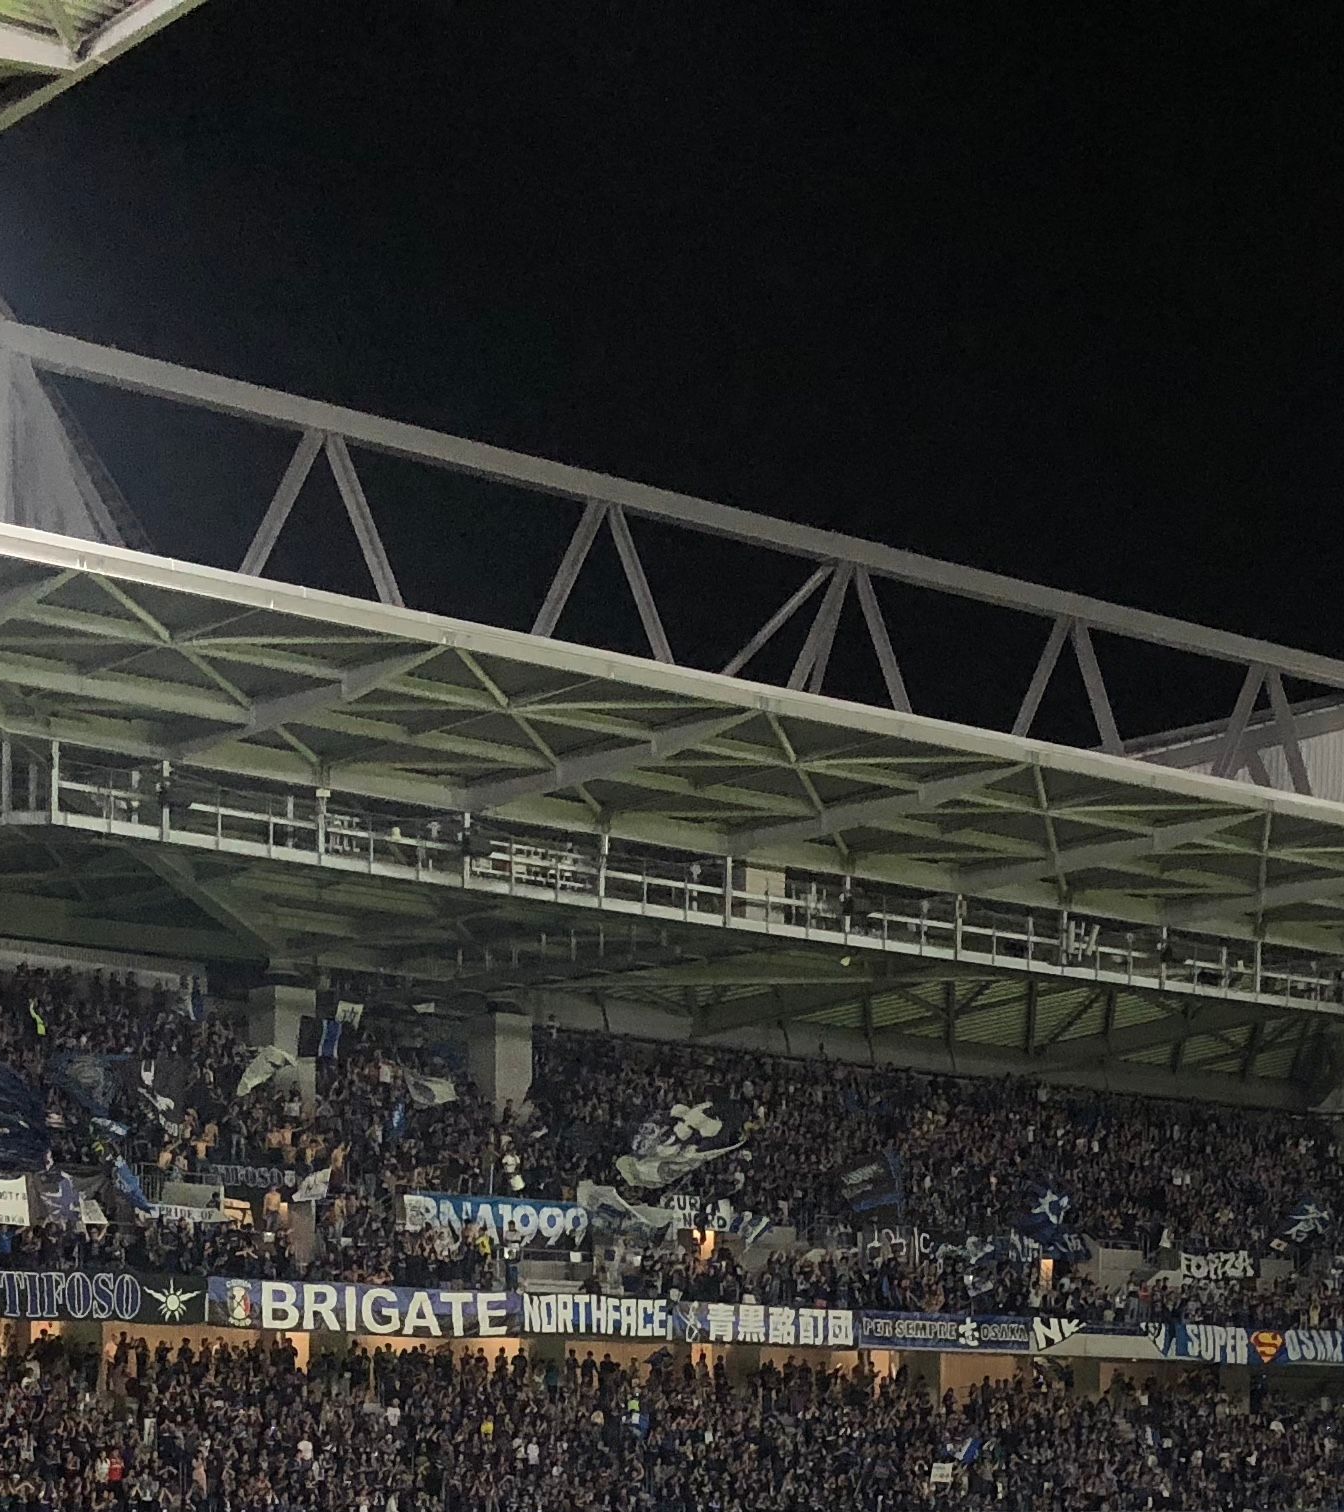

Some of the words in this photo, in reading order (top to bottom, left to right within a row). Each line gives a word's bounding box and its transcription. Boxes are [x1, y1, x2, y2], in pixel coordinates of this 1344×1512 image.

[667, 1194, 722, 1212] CURA
[1182, 1250, 1254, 1280] FORZA
[262, 1280, 508, 1337] BRIGATE
[523, 1293, 668, 1338] NORTHFACE
[862, 1317, 892, 1337] PER
[895, 1318, 957, 1340] SEMPRE
[981, 1323, 1029, 1341] OSAKA
[1185, 1324, 1249, 1364] SUPER
